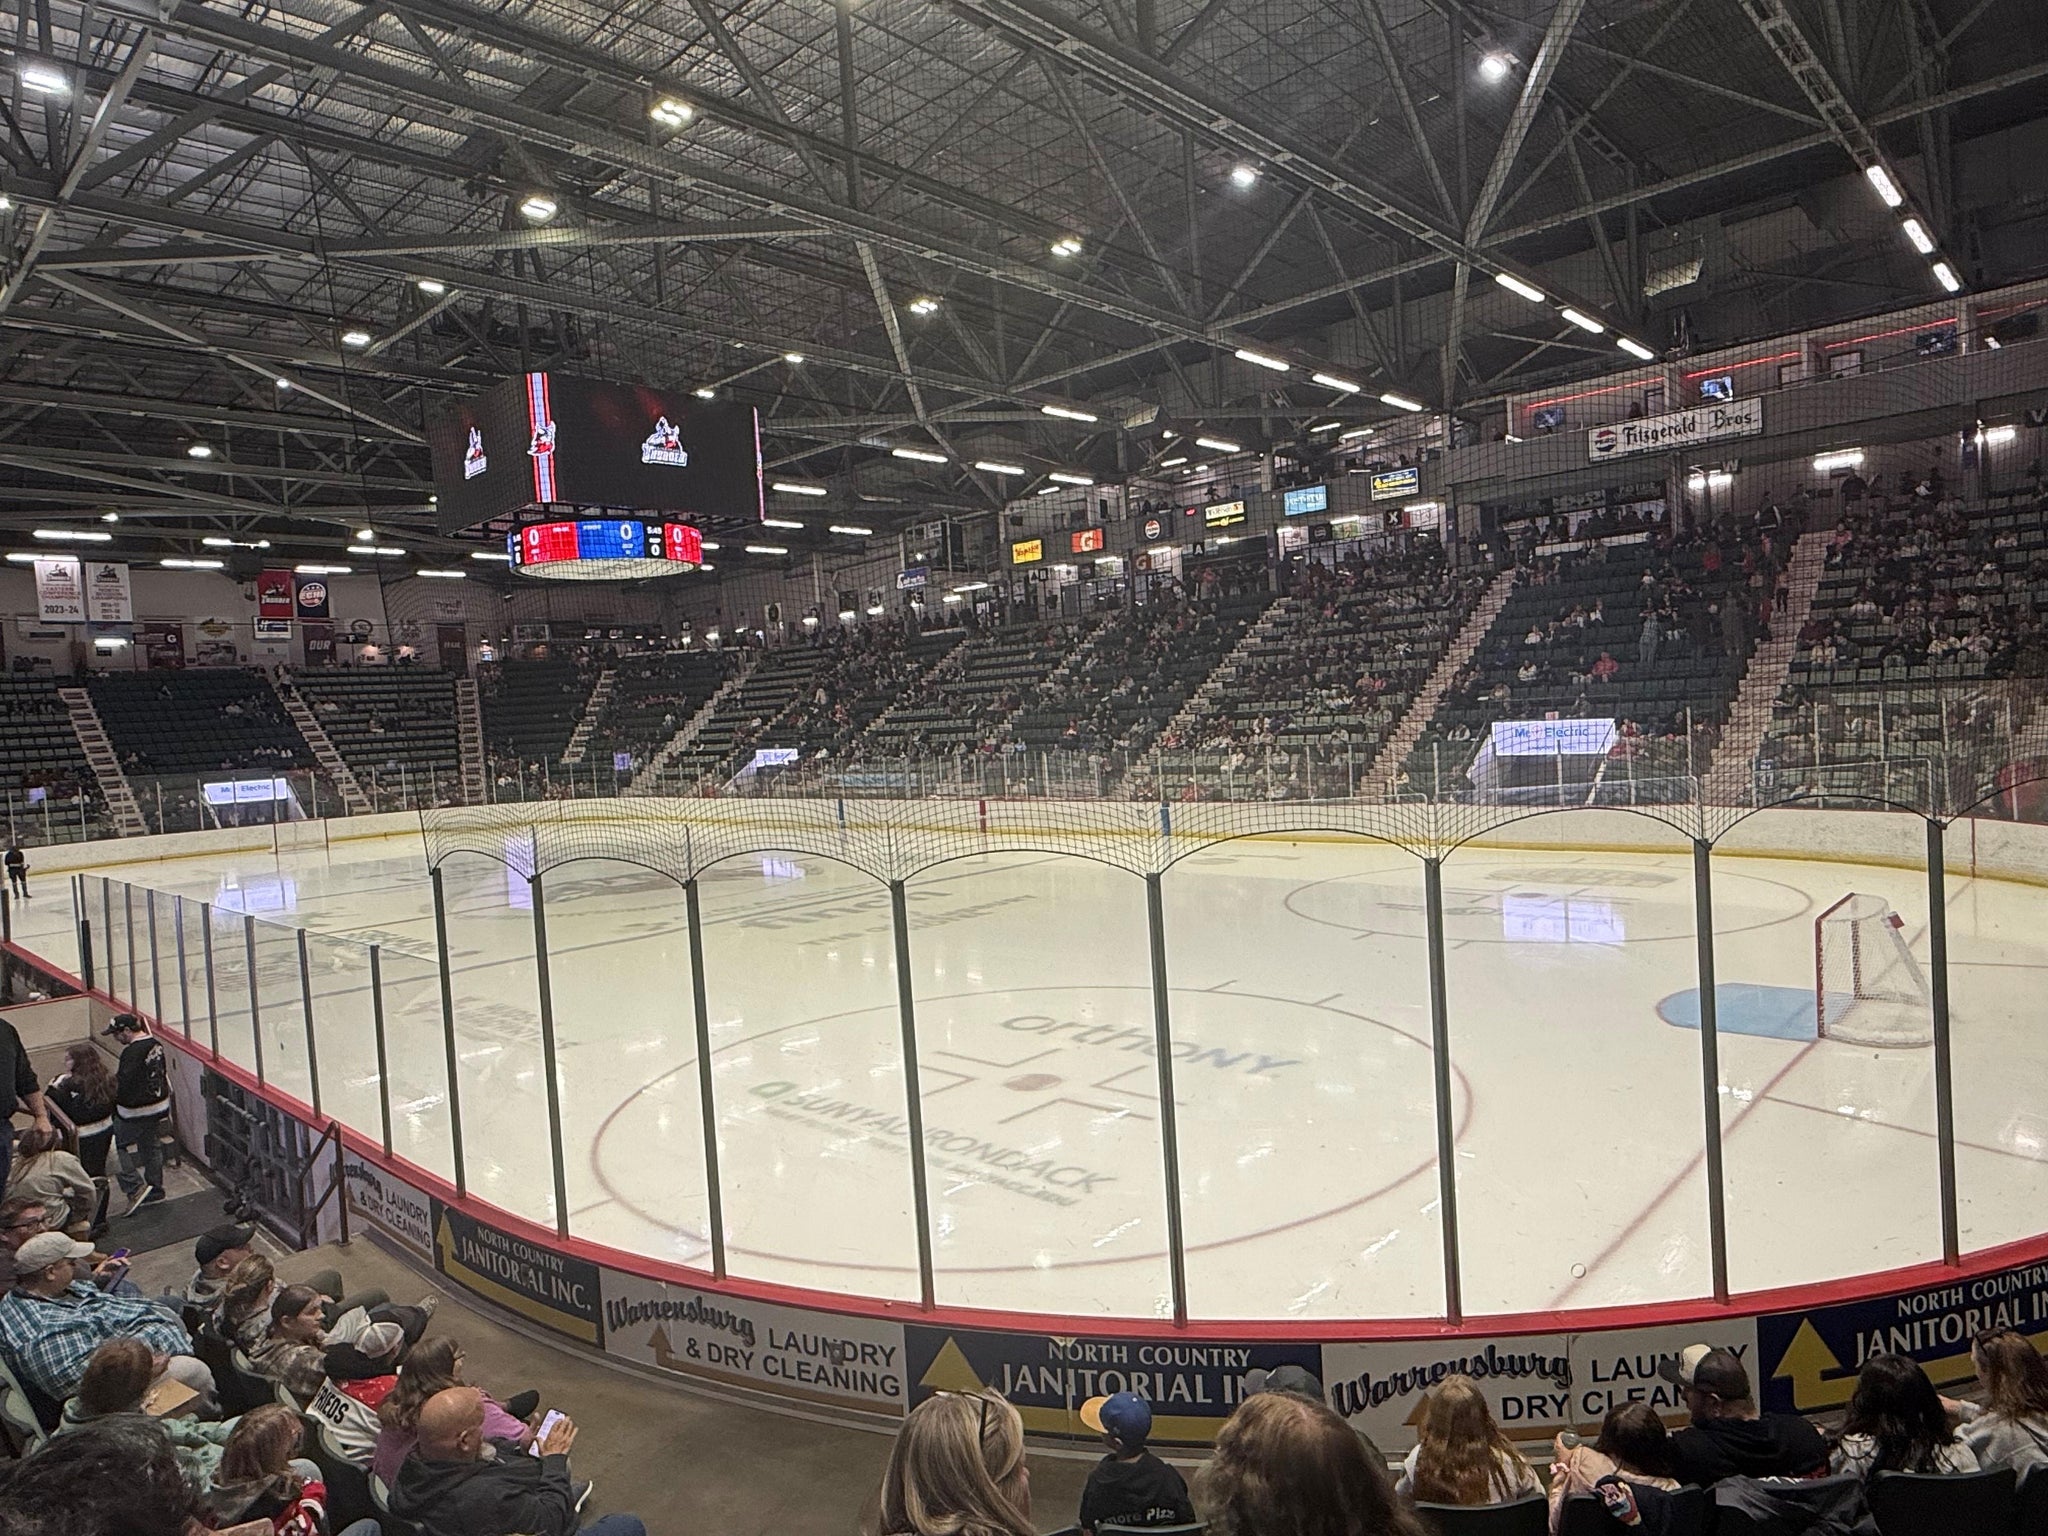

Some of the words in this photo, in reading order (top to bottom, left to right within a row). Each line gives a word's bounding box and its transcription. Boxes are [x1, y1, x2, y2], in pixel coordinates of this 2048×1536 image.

[1622, 415, 1696, 447] Fitzgerald
[1710, 408, 1758, 430] Bros.
[529, 529, 539, 546] 0
[620, 524, 632, 541] 0
[651, 544, 660, 556] 0
[672, 527, 682, 544] 0
[44, 604, 79, 614] 2023-24
[385, 1187, 429, 1227] LAUNDRY
[477, 1225, 511, 1252] NORTH
[512, 1242, 565, 1273] COUNTRY
[1897, 1286, 1964, 1318] NORTH
[606, 1296, 756, 1348] Warrensburg
[1855, 1298, 2026, 1369] JANITORIAL
[686, 1337, 702, 1360] &
[707, 1342, 755, 1371] DRY
[762, 1355, 901, 1397] CLEANING
[1048, 1341, 1128, 1364] NORTH
[1138, 1346, 1251, 1368] COUNTRY
[1002, 1363, 1213, 1404] JANITORIAL
[1331, 1344, 1574, 1418] Warrensburg
[1502, 1393, 1570, 1421] DRY
